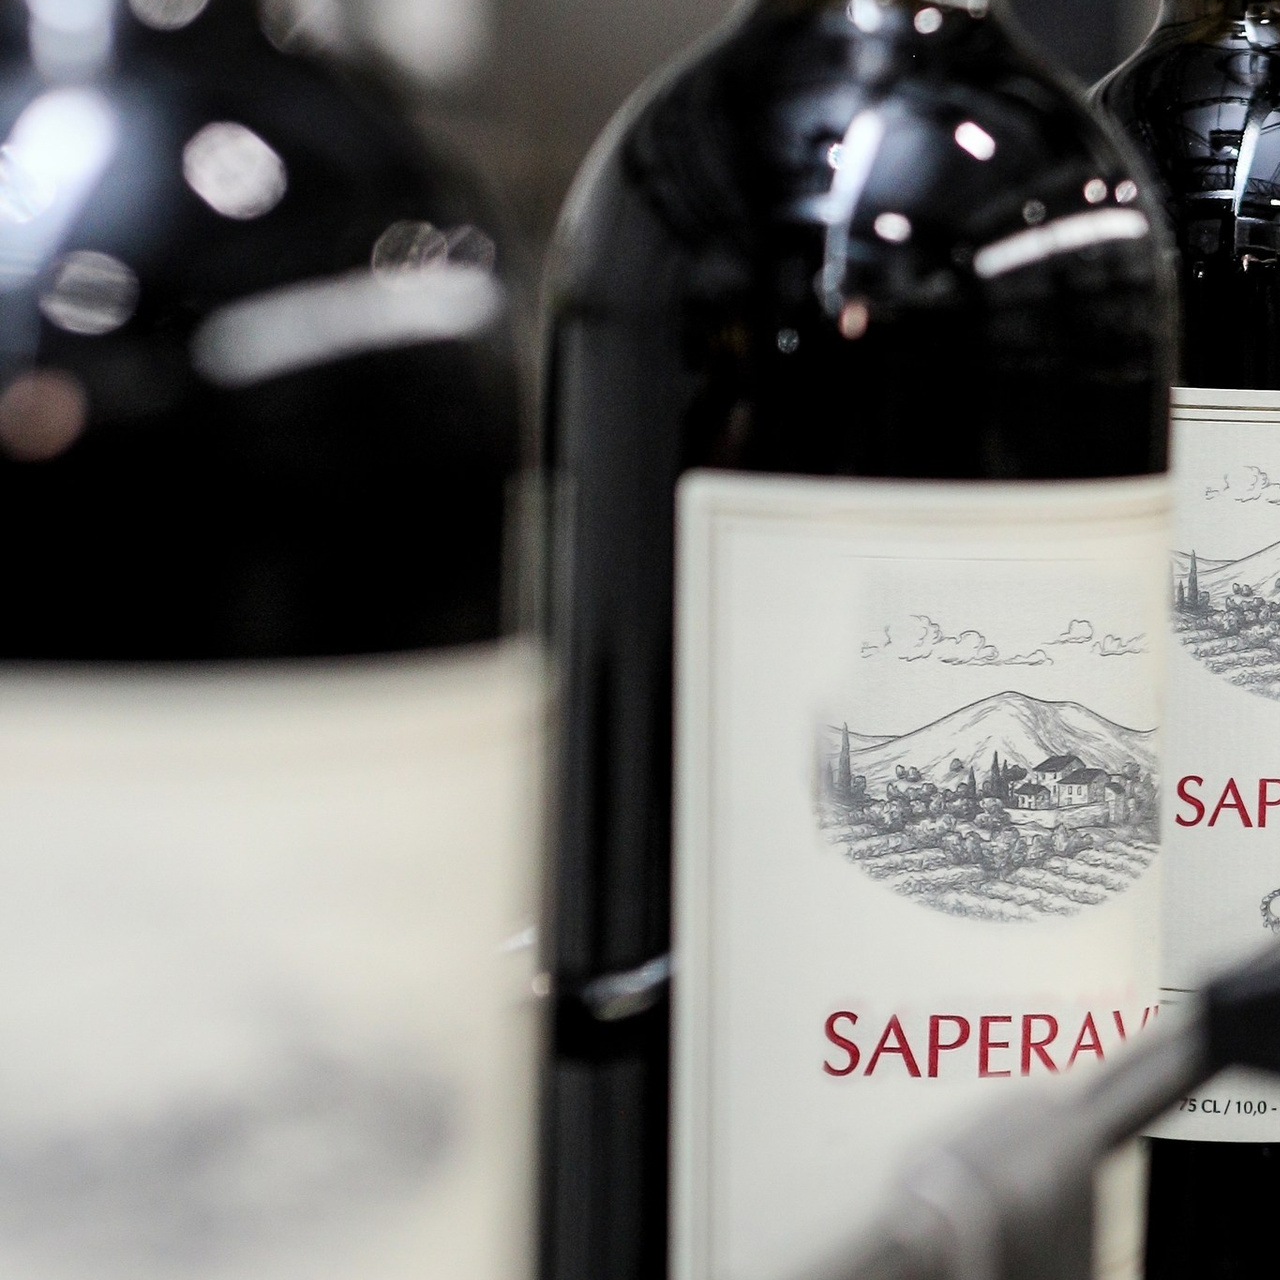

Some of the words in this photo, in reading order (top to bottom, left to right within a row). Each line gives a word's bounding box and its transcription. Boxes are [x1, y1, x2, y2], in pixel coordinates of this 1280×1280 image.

[822, 1004, 1160, 1079] SAPERAV
[1201, 1098, 1221, 1114] CL
[1223, 1099, 1231, 1116] /
[1235, 1100, 1267, 1117] 10,0
